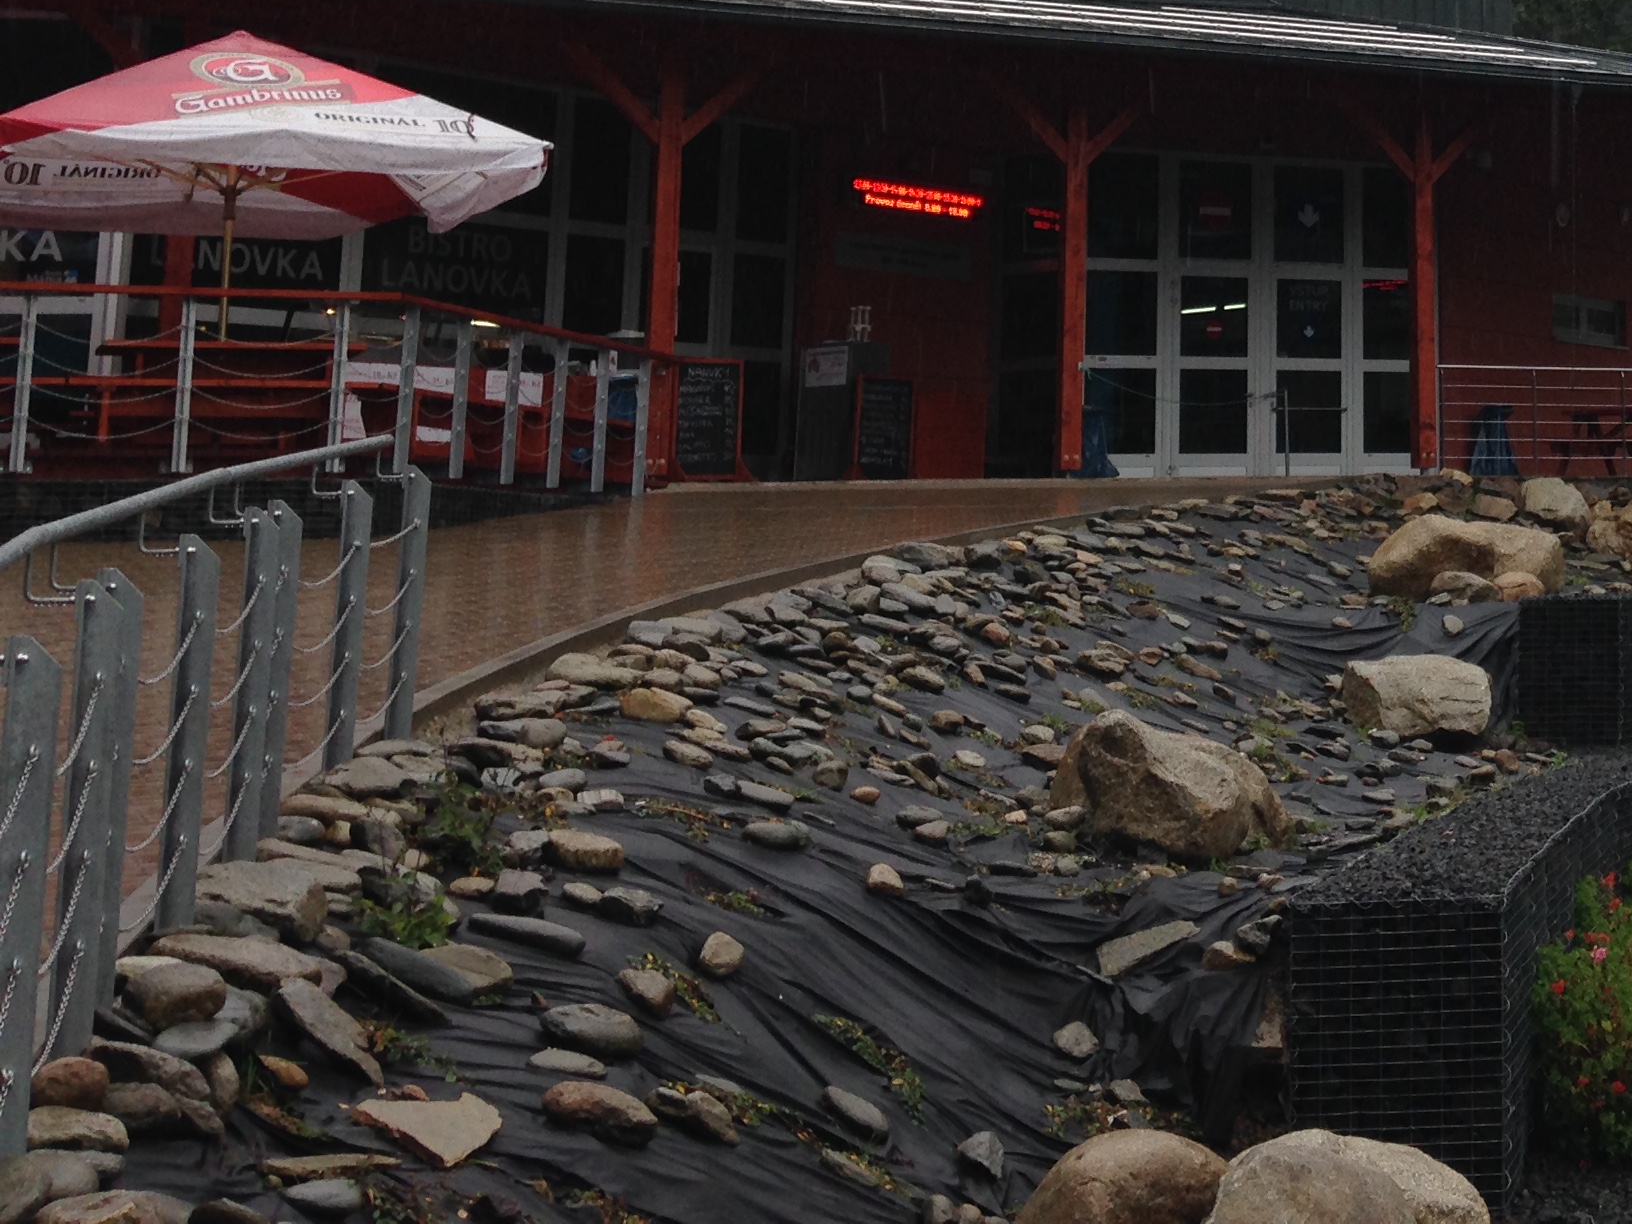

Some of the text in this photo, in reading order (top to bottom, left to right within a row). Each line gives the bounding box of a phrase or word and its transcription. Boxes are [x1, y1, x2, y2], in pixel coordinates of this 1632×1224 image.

[174, 87, 342, 114] Gambrinus
[151, 235, 324, 281] LNOVKA
[408, 225, 512, 261] BISTRO
[381, 258, 532, 299] LANOVKA
[1288, 284, 1329, 298] VSTUP
[1288, 299, 1329, 312] ENTRY
